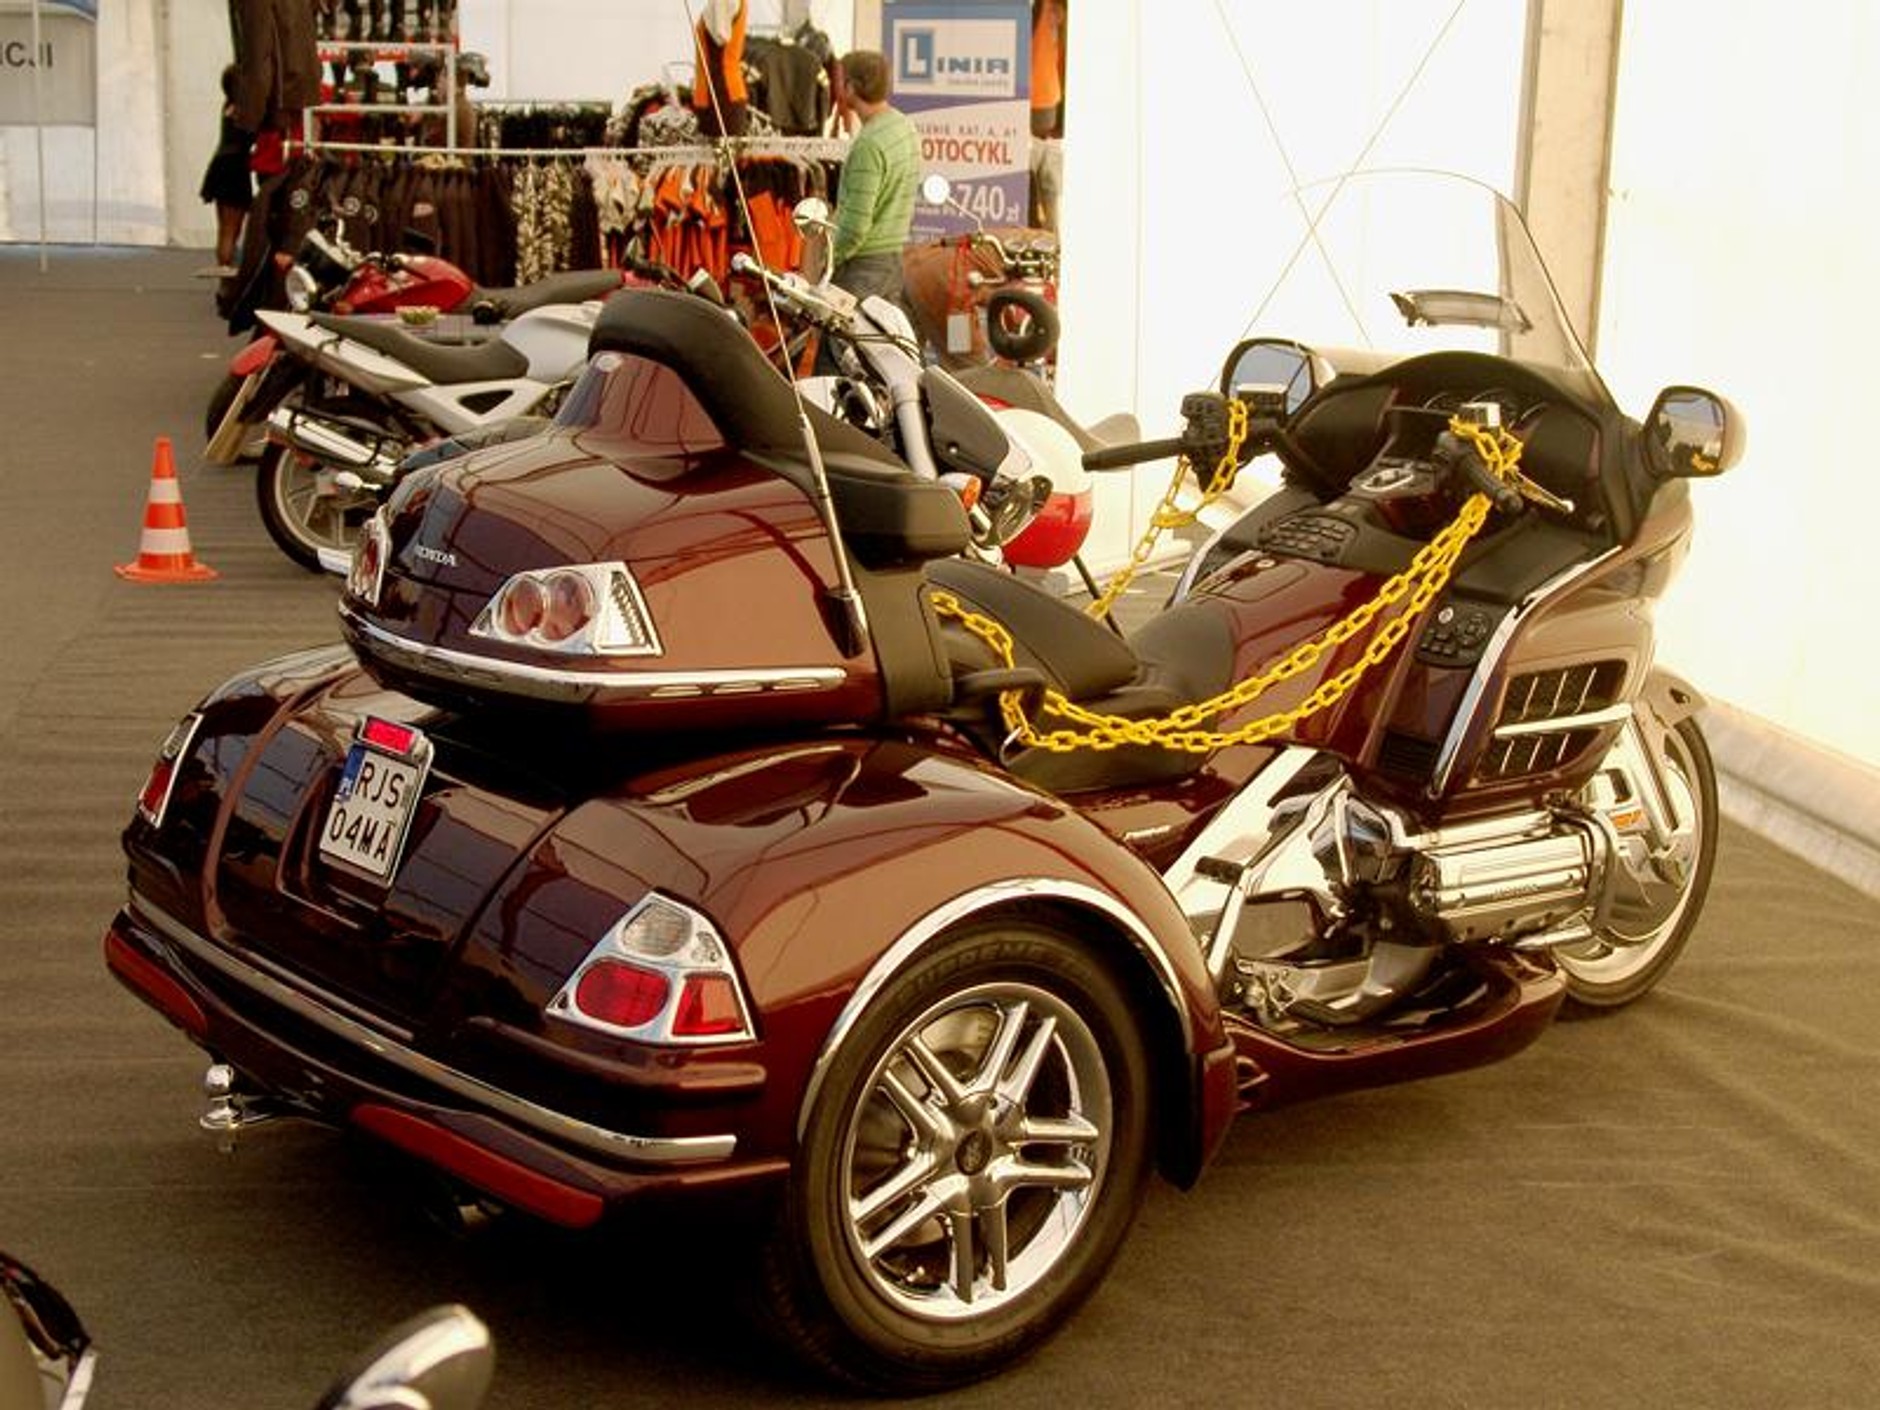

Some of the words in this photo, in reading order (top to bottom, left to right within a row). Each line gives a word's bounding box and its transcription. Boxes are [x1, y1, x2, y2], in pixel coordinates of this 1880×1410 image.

[0, 42, 53, 68] CJI
[920, 138, 1012, 165] OTOCYKL
[355, 761, 405, 809] RJS
